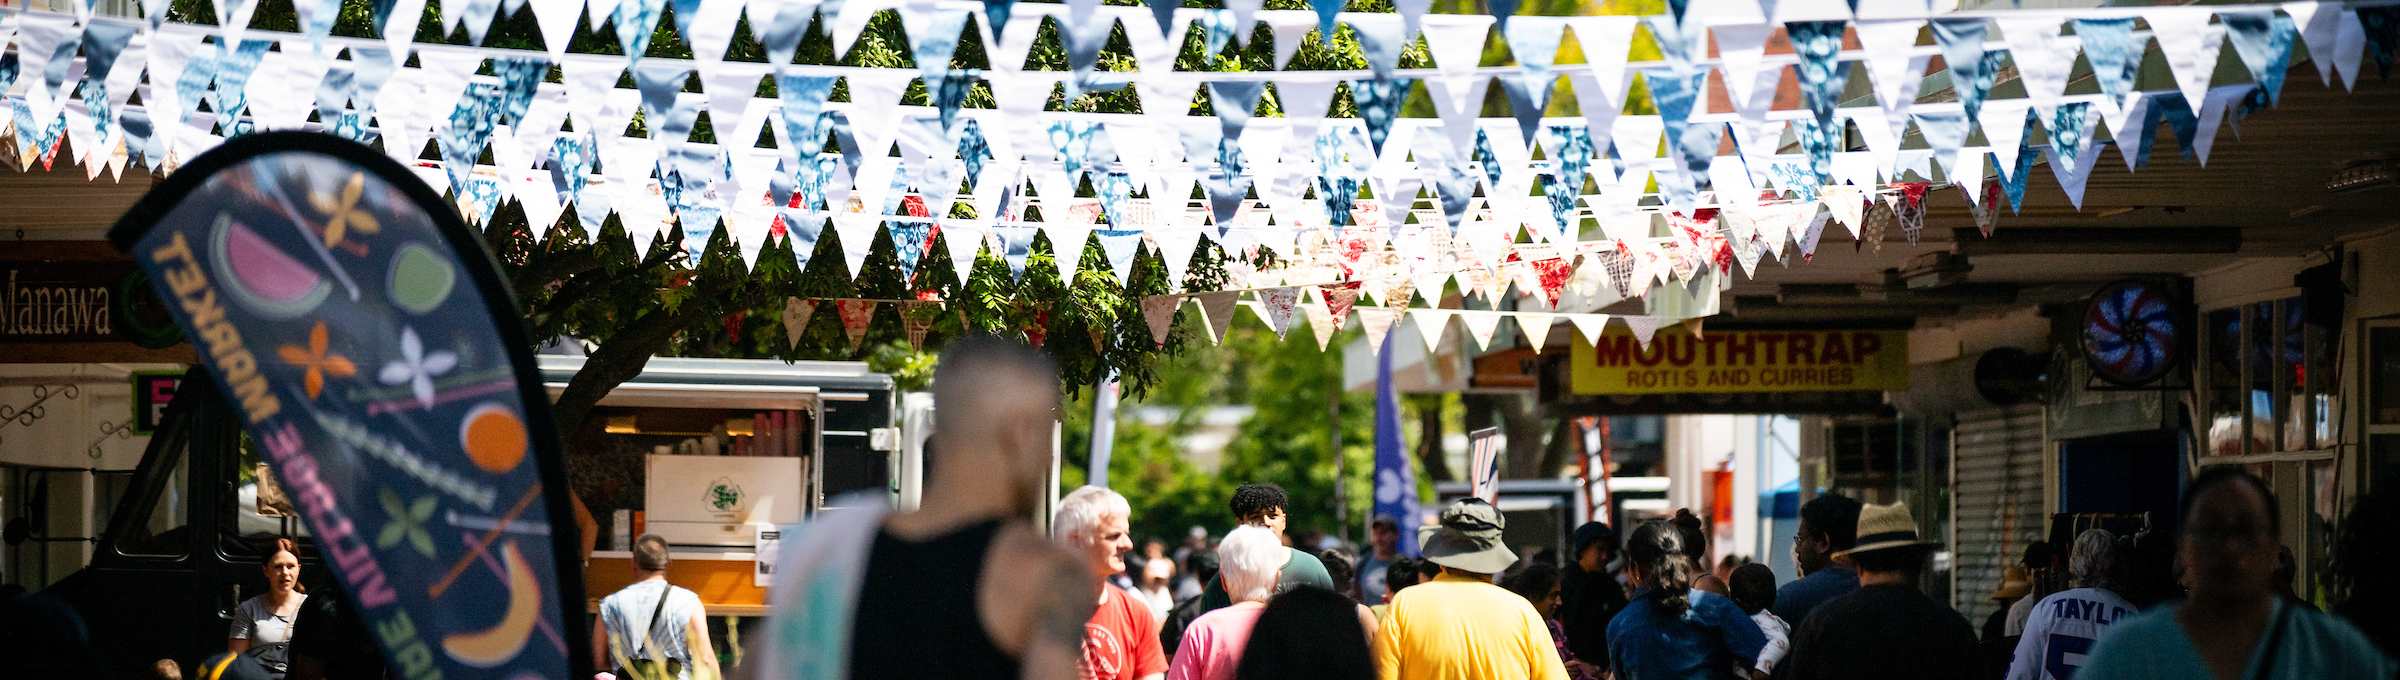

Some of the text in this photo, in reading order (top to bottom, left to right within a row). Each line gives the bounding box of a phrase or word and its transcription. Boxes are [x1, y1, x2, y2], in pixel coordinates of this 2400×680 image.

[1597, 332, 1882, 367] MOUTHTRAP
[1627, 366, 1853, 387] ROTIS AND CURRIES
